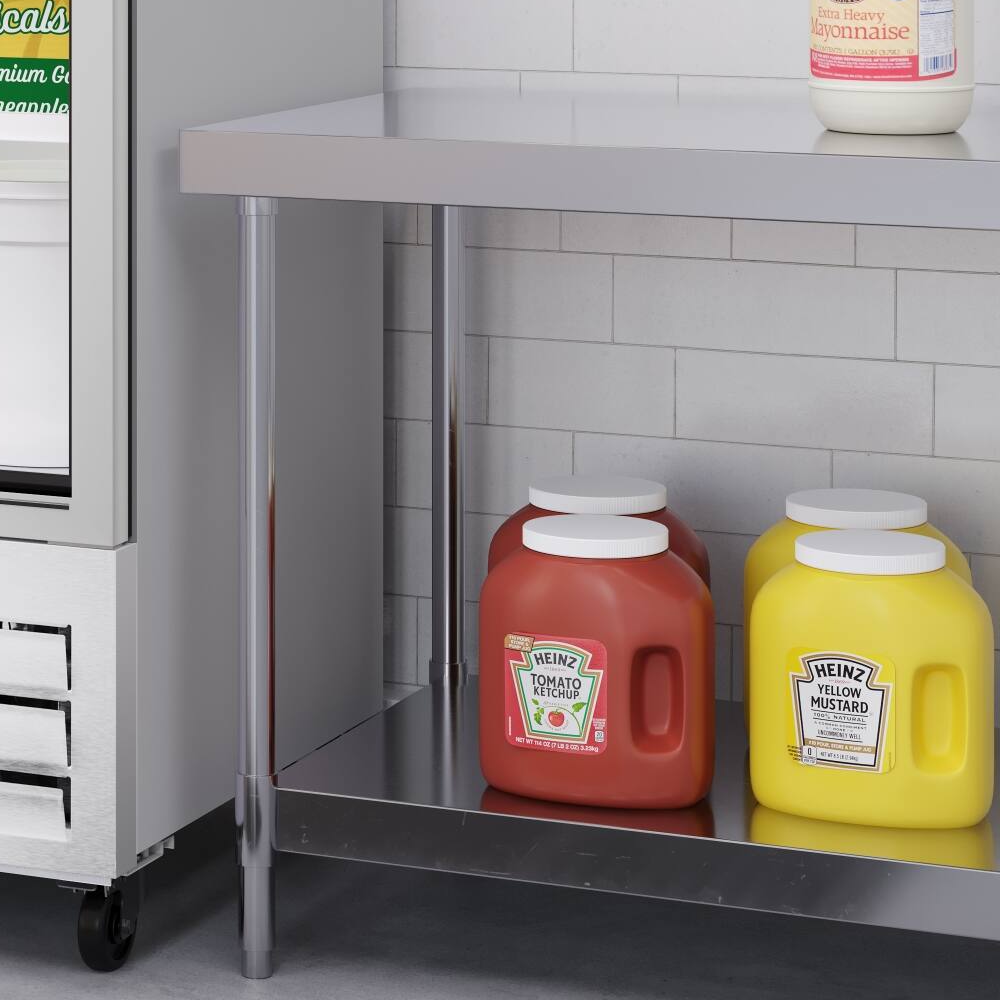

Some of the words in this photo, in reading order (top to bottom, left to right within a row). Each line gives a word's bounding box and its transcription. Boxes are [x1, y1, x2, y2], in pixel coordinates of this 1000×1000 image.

[818, 6, 840, 20] Extra
[843, 9, 885, 24] Heavy
[810, 16, 910, 41] Mayonnaise
[533, 652, 578, 669] HEINZ
[814, 663, 866, 682] HEINZ
[531, 673, 581, 690] TOMATO
[533, 686, 580, 700] KETCHUP
[818, 684, 861, 699] YELLOW
[811, 696, 868, 713] MUSTARD
[833, 715, 866, 723] NATURAL
[849, 732, 861, 740] WELL
